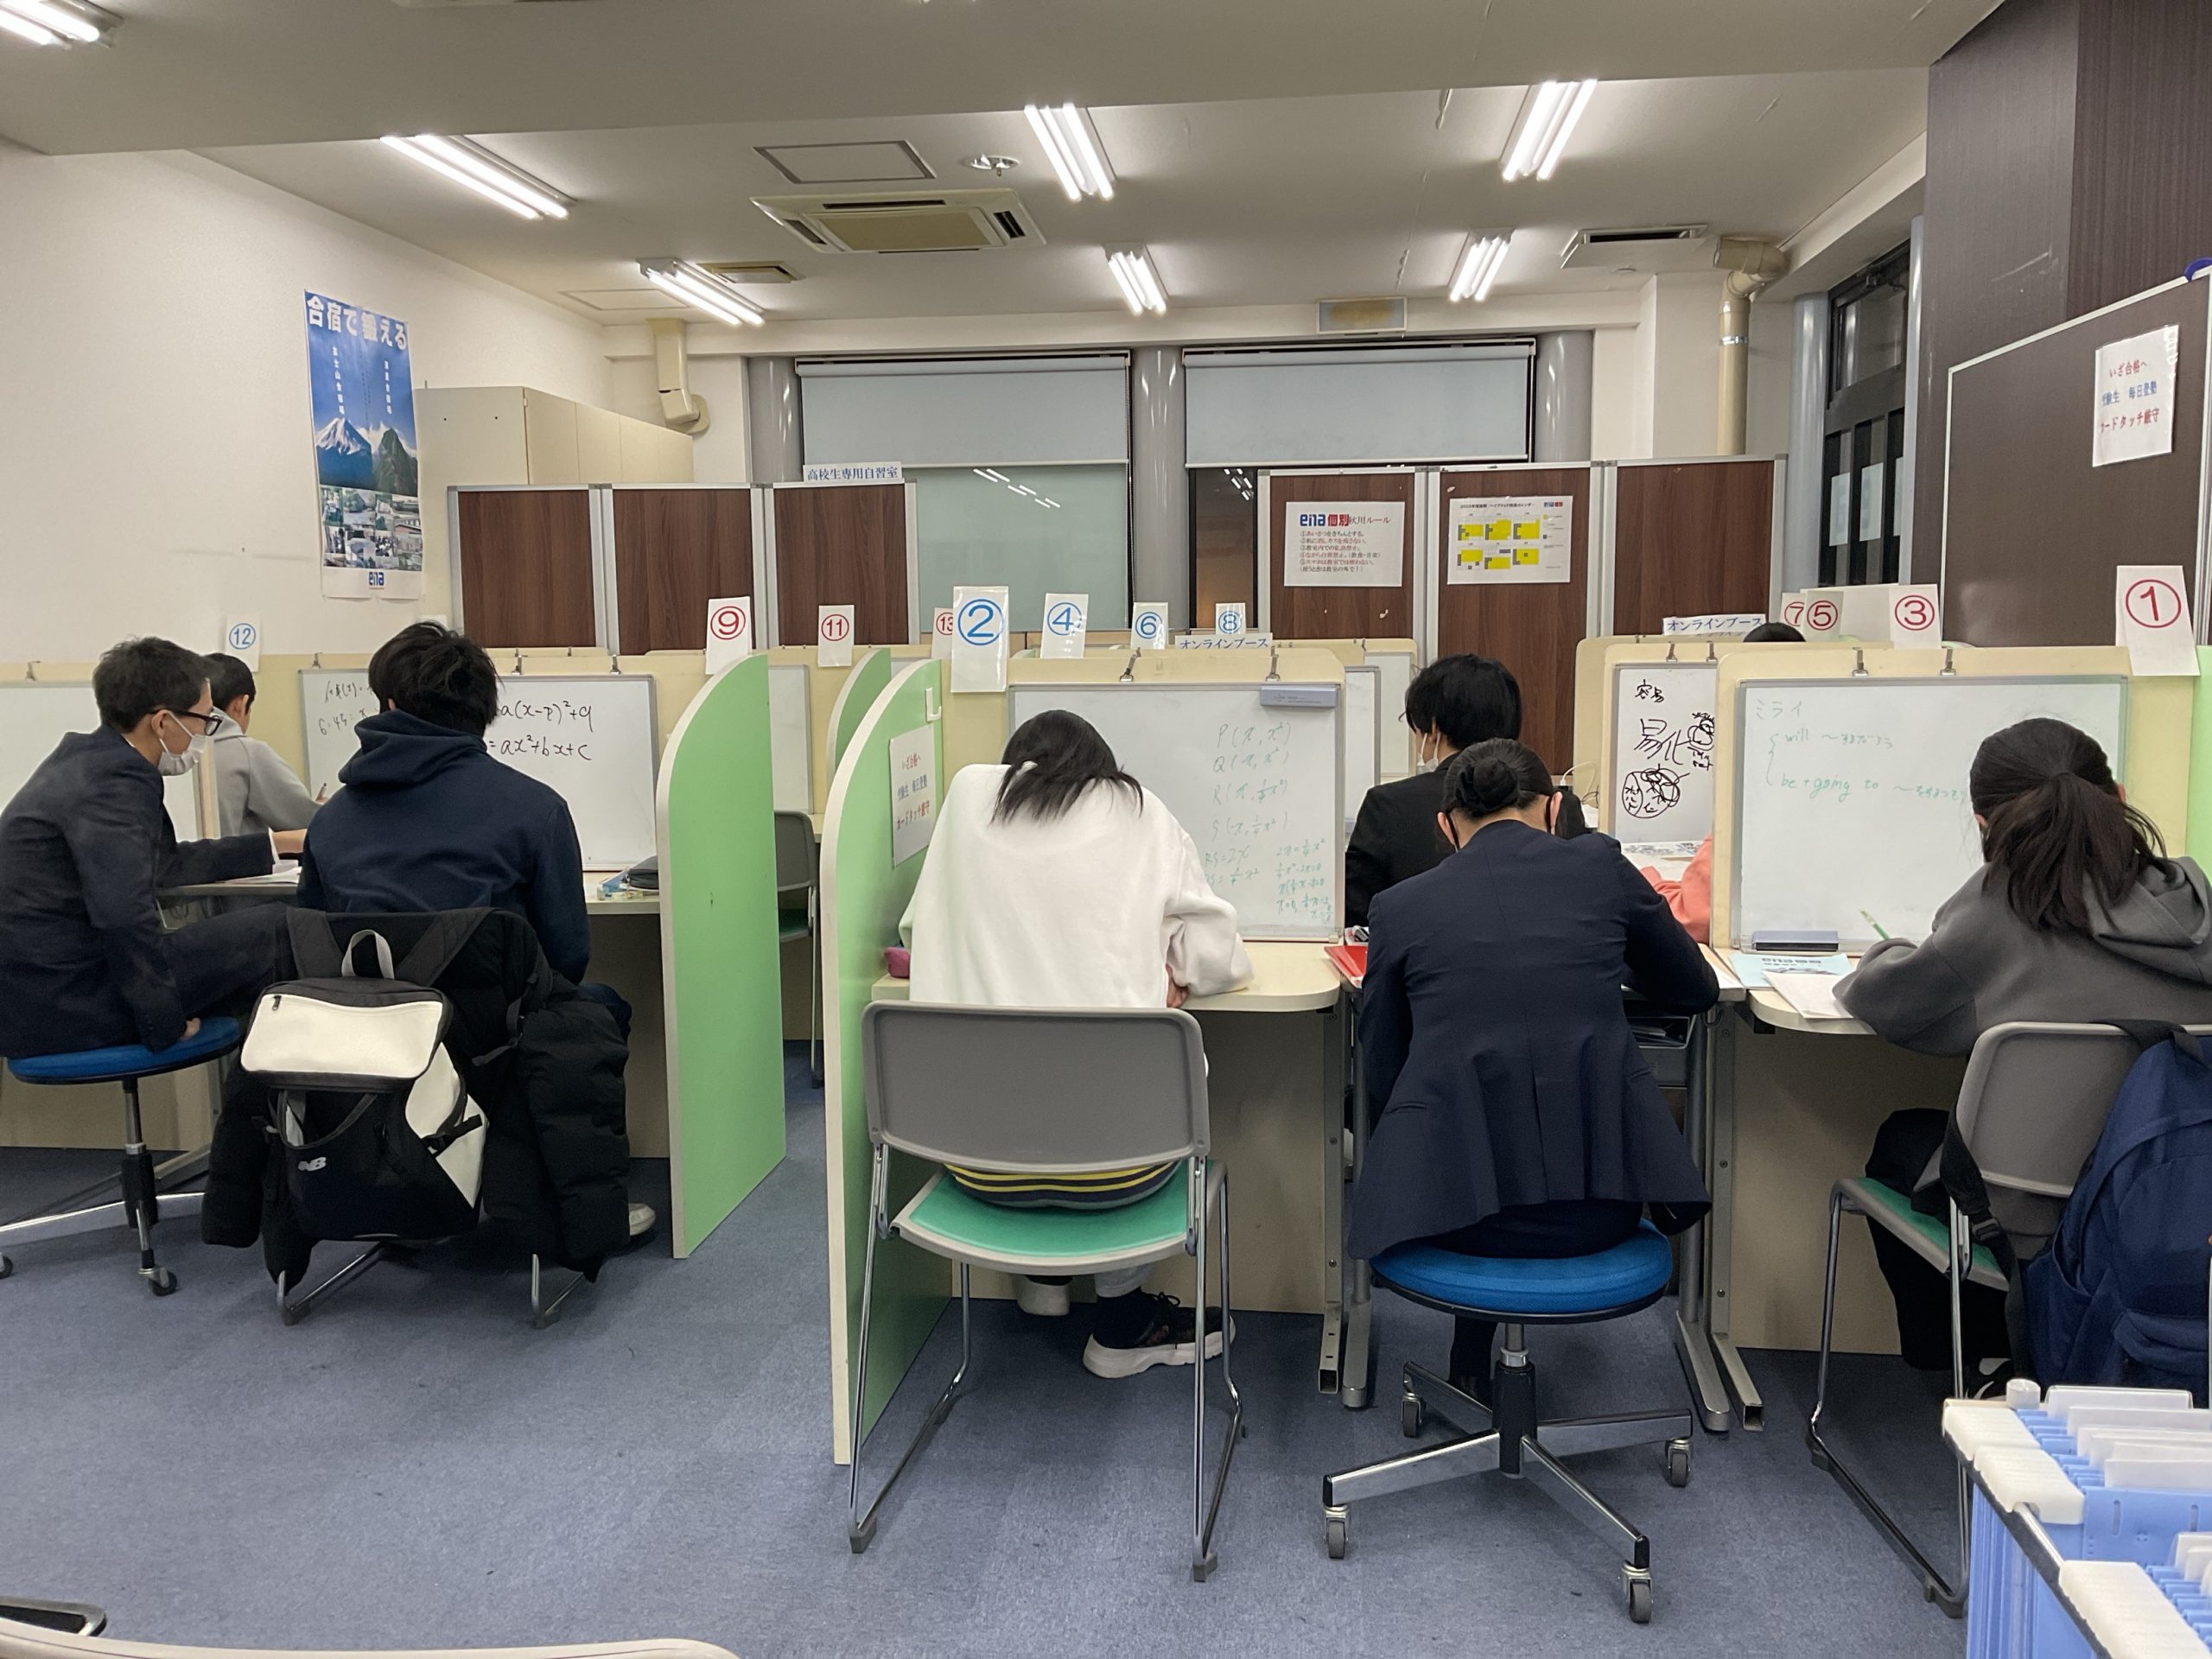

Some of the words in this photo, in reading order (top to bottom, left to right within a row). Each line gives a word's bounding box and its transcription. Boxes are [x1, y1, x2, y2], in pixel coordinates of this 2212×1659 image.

[2109, 359, 2147, 378] いざ合格へ
[807, 466, 899, 481] 高校生専用自習室
[1300, 514, 1325, 526] ena
[369, 571, 385, 586] ena
[1667, 617, 1763, 632] オンラインブース
[1179, 638, 1268, 650] オンラインブース
[1785, 728, 1808, 741] will
